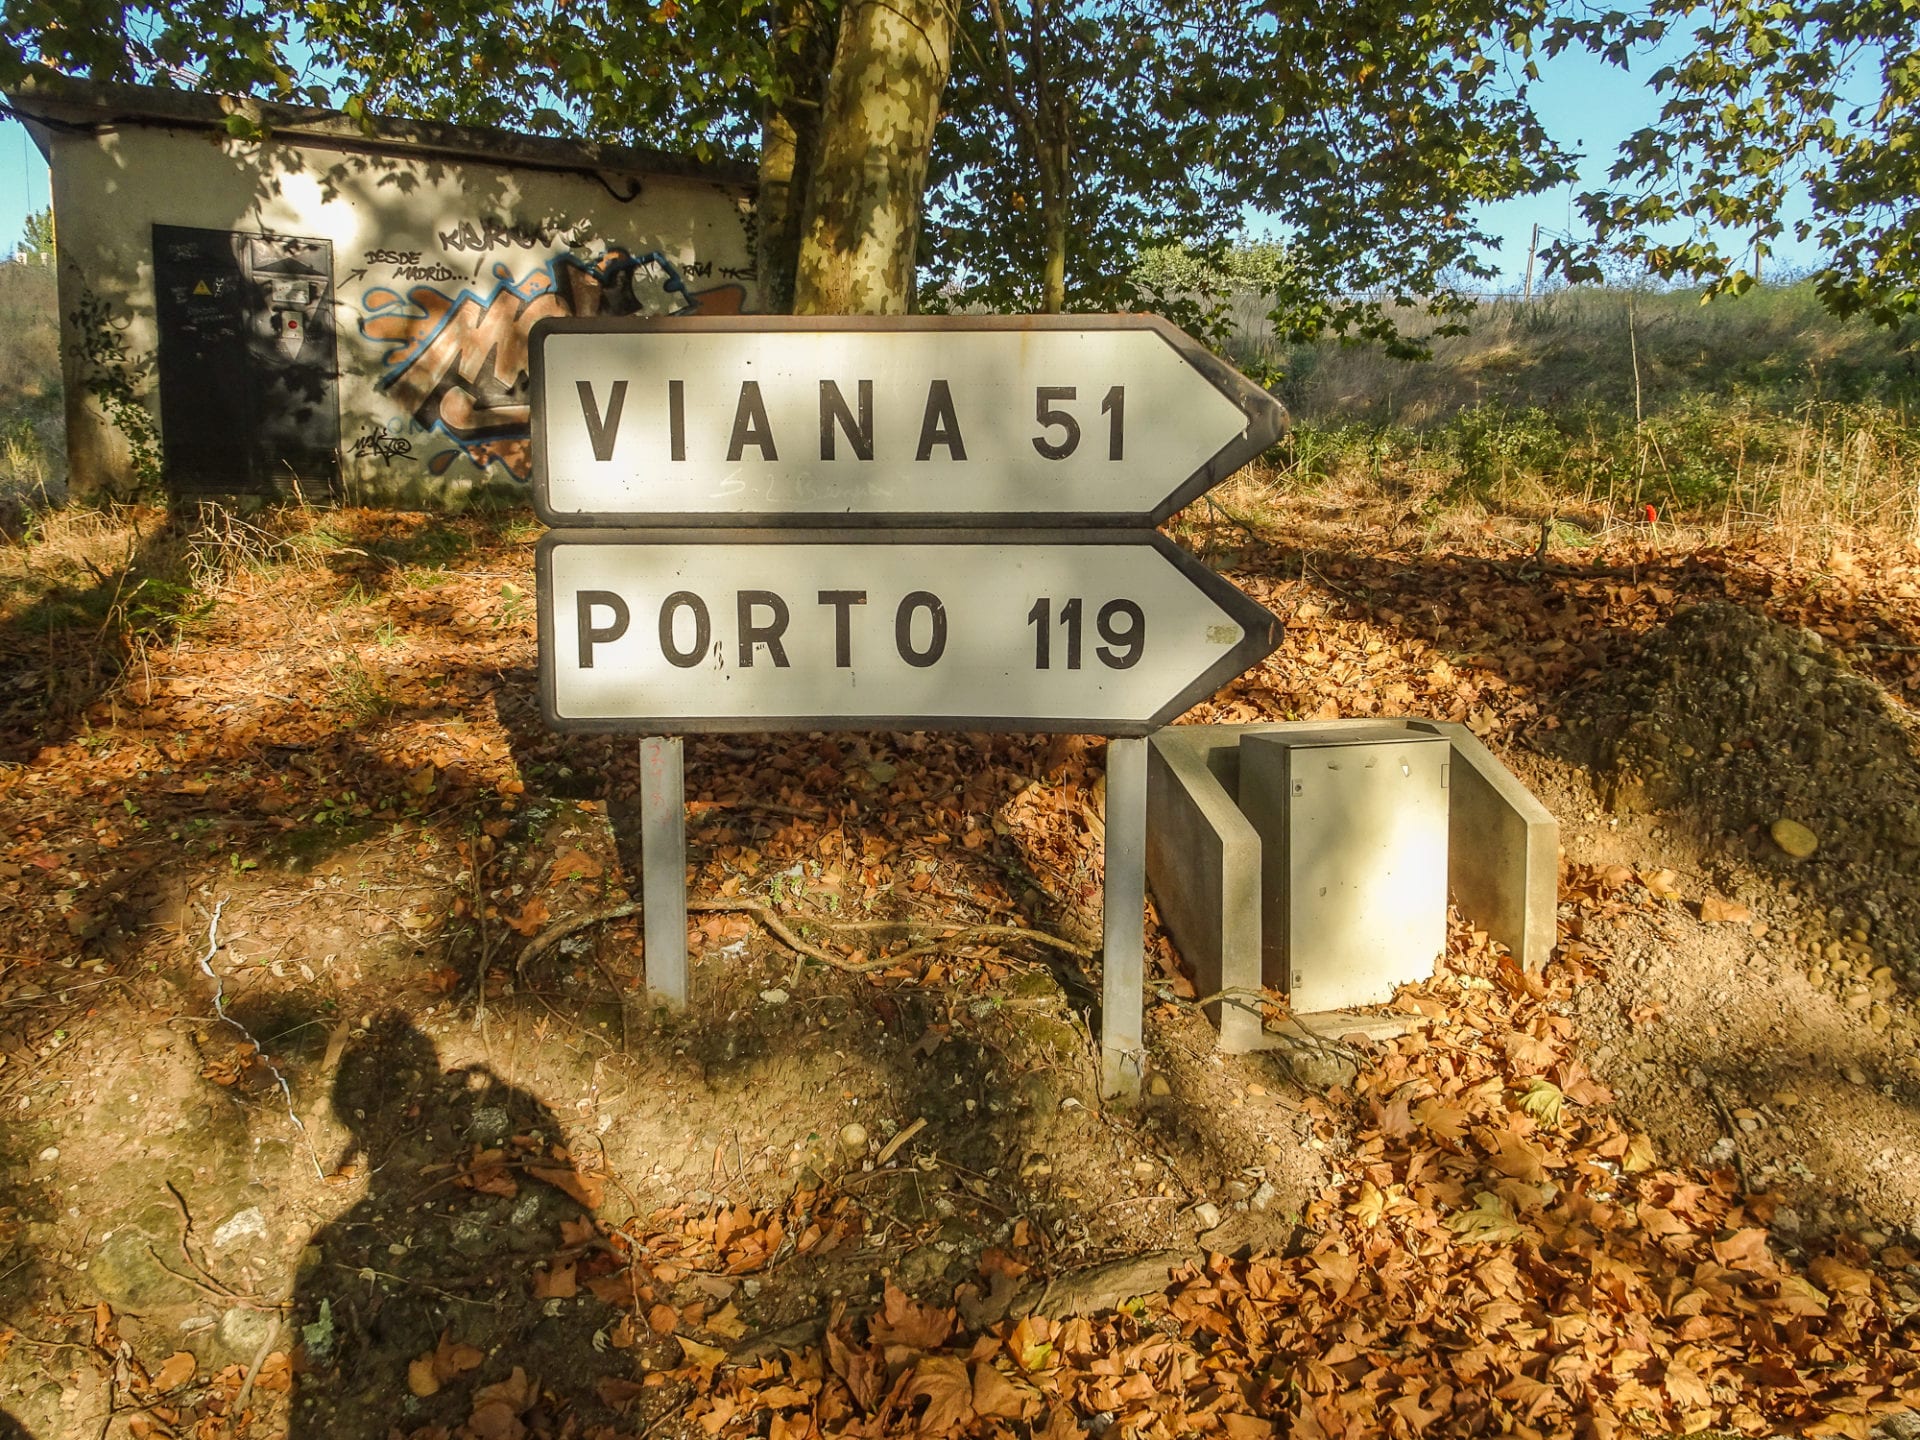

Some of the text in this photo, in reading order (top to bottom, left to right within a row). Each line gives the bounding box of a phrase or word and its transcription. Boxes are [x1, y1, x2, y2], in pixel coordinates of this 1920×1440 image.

[364, 248, 423, 265] DESDE
[575, 379, 1125, 461] VIANA 51
[576, 589, 1146, 670] PORTO 119
